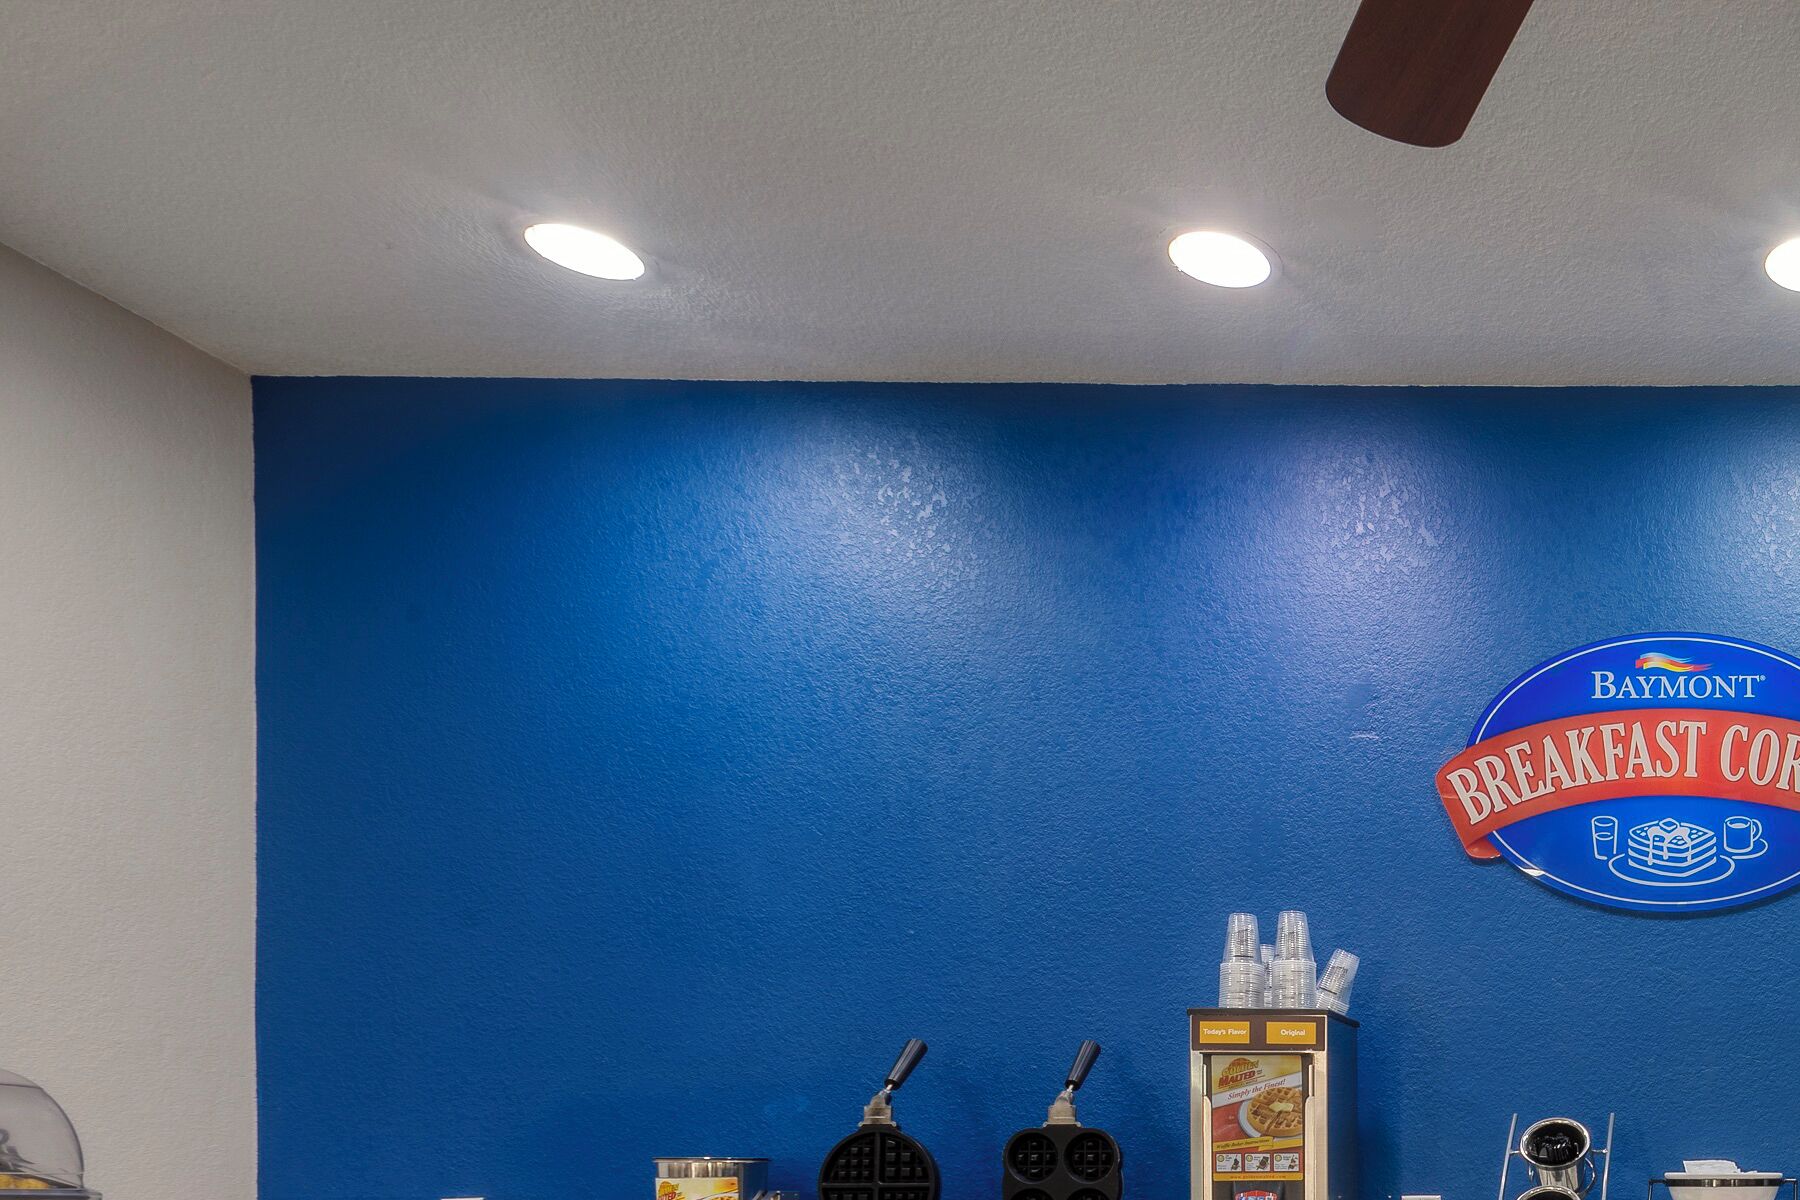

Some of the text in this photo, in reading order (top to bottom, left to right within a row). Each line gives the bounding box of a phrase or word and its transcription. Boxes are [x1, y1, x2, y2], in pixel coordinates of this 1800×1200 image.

[1445, 719, 1710, 826] BREAKFAST
[1203, 1028, 1226, 1036] Today's
[1280, 1029, 1306, 1037] Original
[1217, 1069, 1256, 1088] MALTED
[1227, 1087, 1252, 1100] Simply
[1252, 1085, 1263, 1094] the
[1264, 1078, 1286, 1091] Finest!
